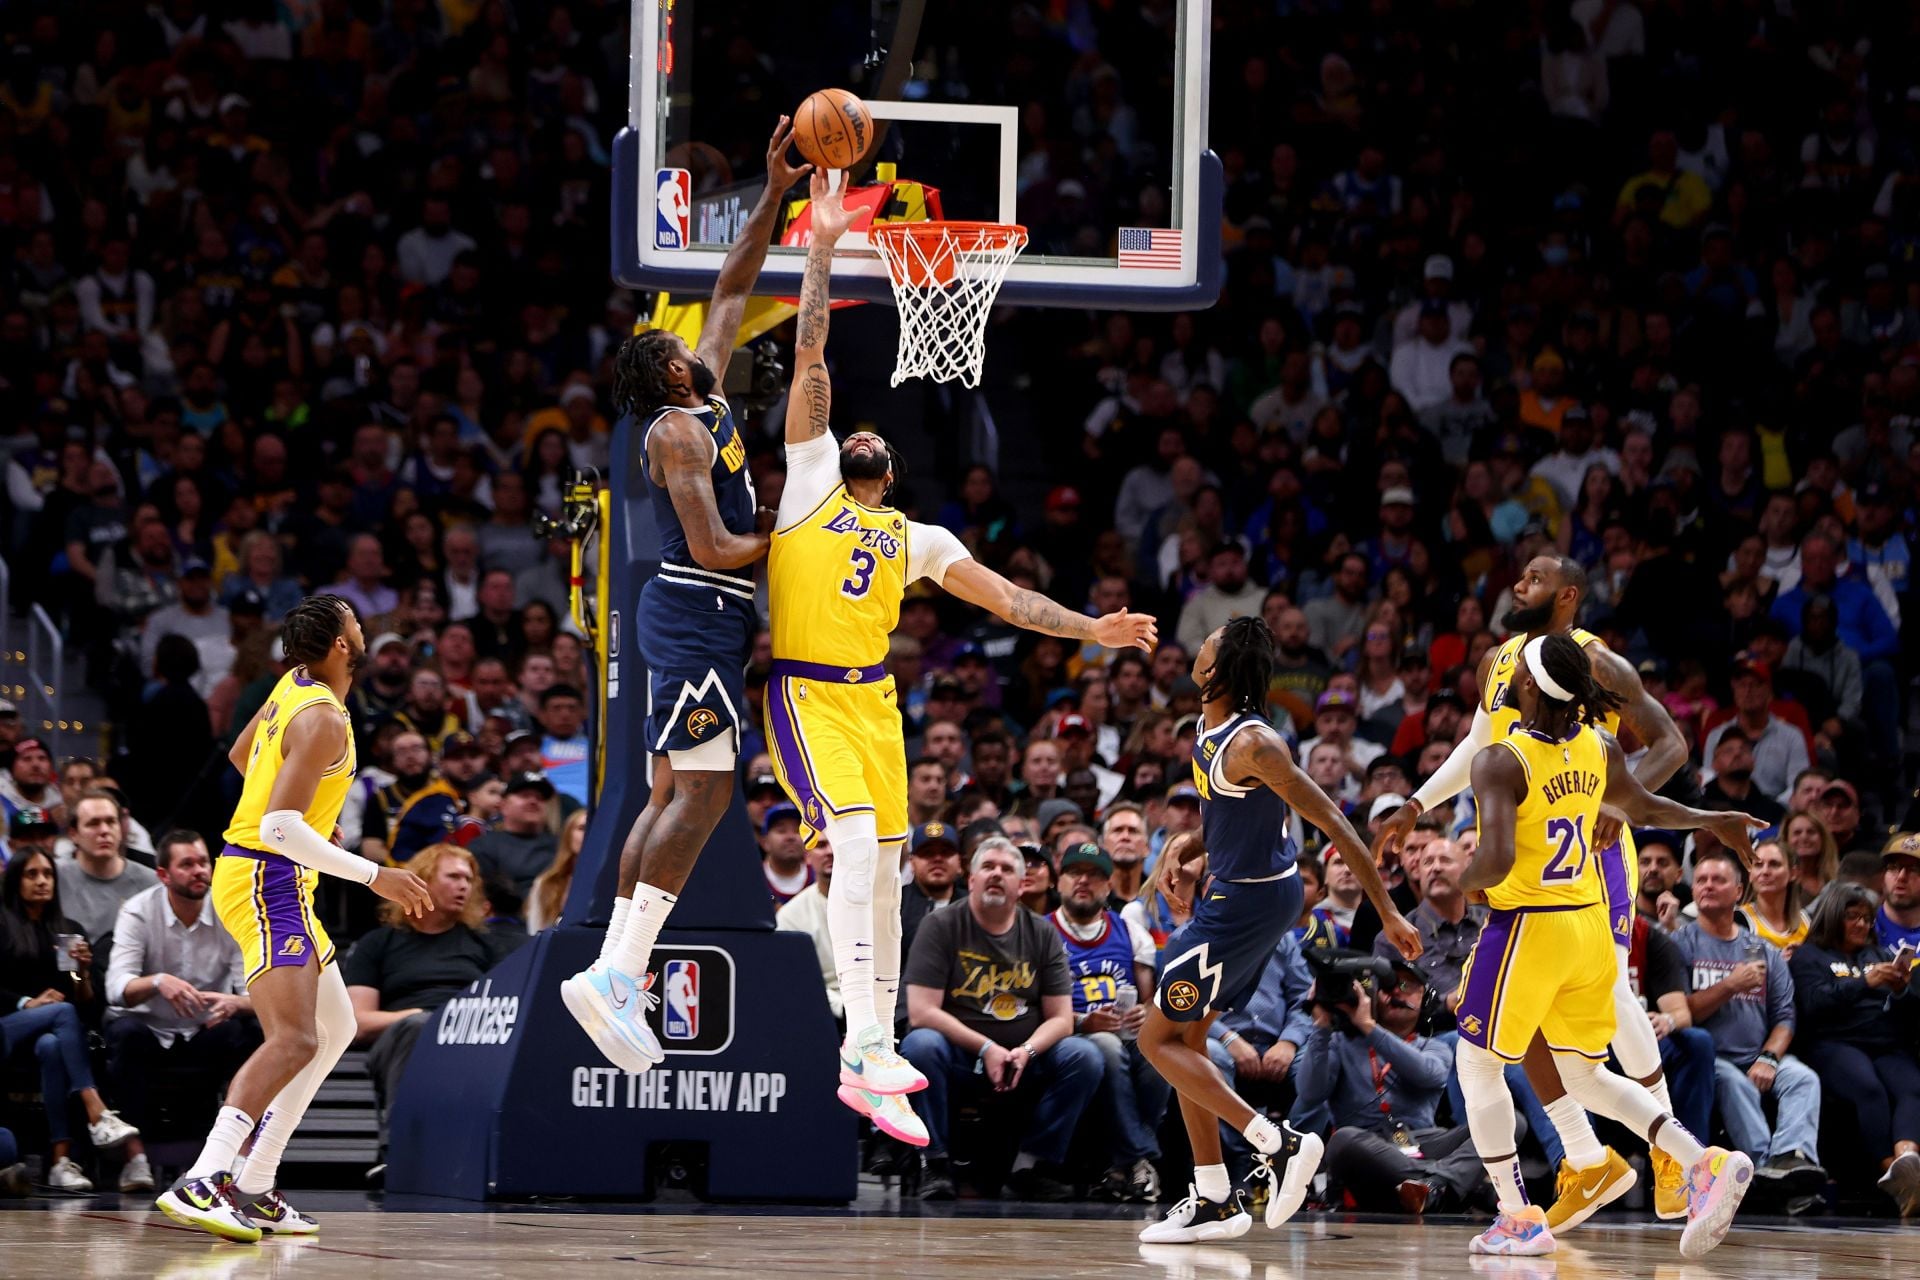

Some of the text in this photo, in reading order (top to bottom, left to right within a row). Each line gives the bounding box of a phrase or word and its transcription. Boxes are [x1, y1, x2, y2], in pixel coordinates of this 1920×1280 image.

[843, 101, 865, 153] Wilson
[659, 231, 677, 246] NBA
[842, 547, 877, 597] 3
[1542, 770, 1600, 806] BEVERLEY
[1541, 814, 1587, 884] 21
[437, 979, 519, 1045] coinbase
[1080, 975, 1117, 1002] 27
[668, 1020, 687, 1034] NBA
[571, 1065, 787, 1113] GET THE NEW APP
